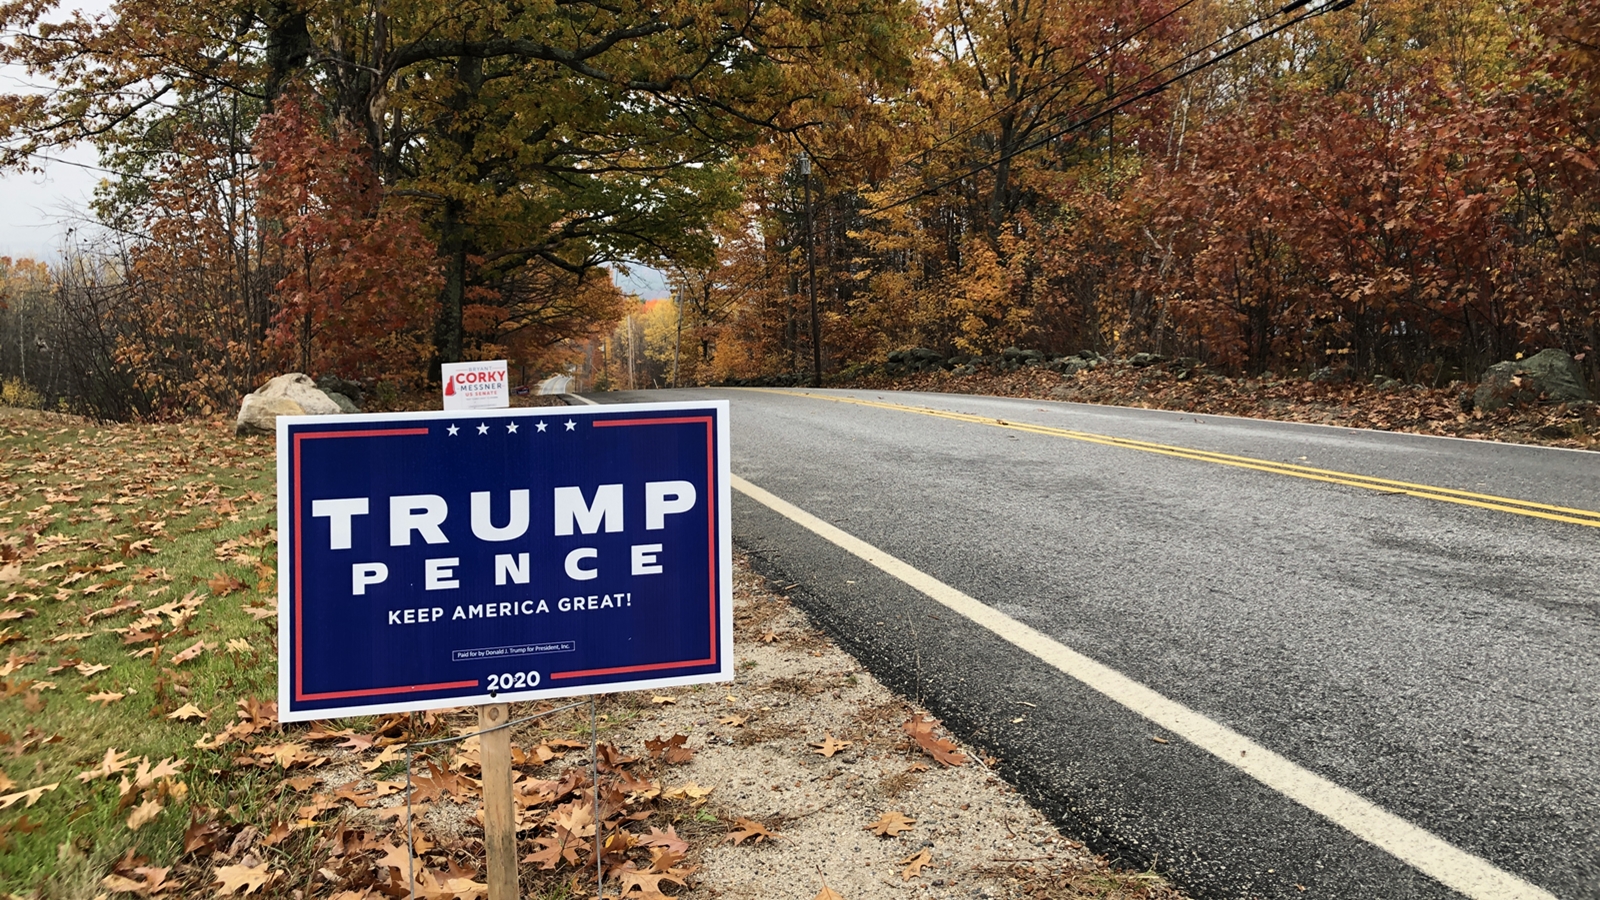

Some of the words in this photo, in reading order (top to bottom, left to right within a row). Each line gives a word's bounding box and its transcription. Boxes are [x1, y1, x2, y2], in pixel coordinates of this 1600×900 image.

[455, 371, 505, 384] CORKY
[460, 383, 502, 391] MESSNER
[311, 480, 697, 550] TRUMP
[352, 543, 664, 595] PENCE
[388, 607, 444, 625] KEEP
[452, 599, 550, 620] AMERICA
[557, 593, 632, 612] GREAT!
[510, 647, 526, 655] Trump
[535, 643, 560, 651] President,
[487, 670, 541, 691] 2020
